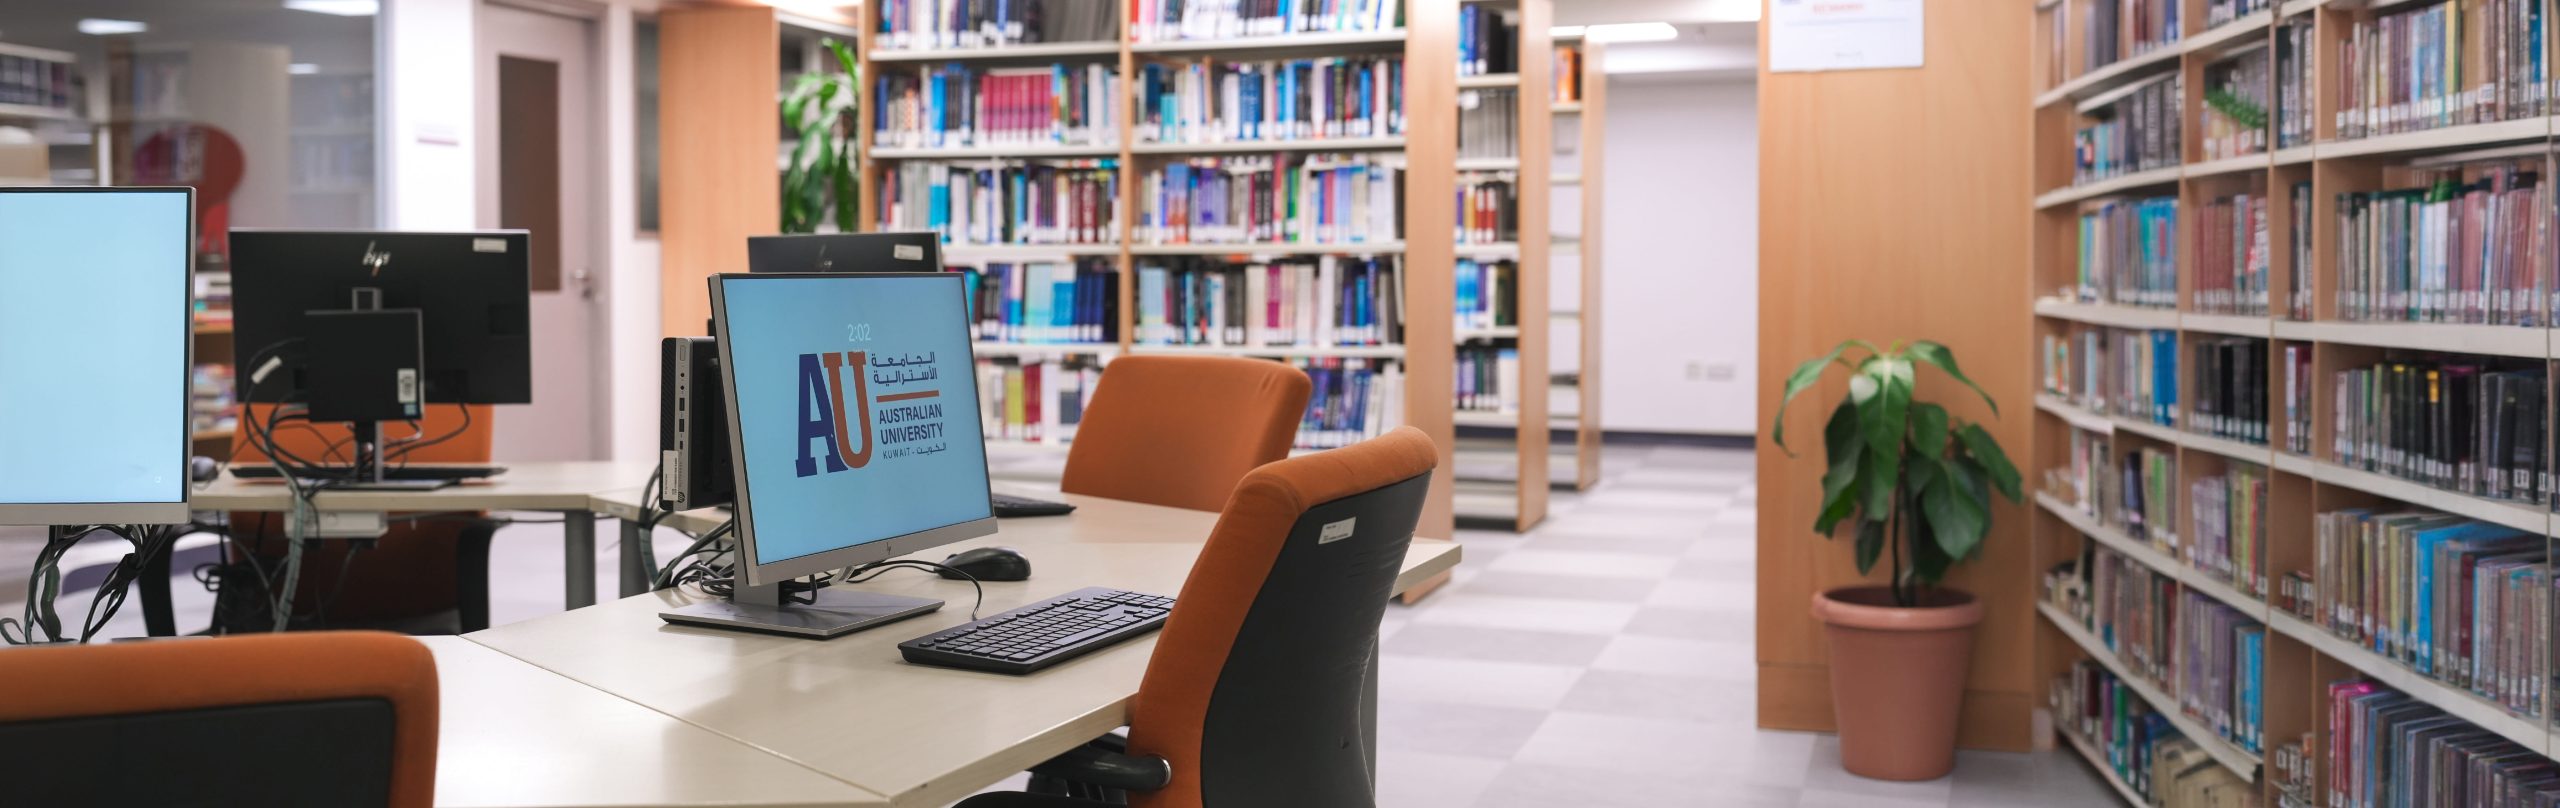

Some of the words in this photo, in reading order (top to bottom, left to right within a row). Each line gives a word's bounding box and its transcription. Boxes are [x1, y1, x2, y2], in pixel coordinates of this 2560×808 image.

[847, 323, 871, 342] 2:02
[871, 351, 936, 368] الجامعة
[873, 367, 938, 387] الأسترالية
[795, 351, 873, 478] AU
[879, 403, 943, 425] AUSTRALIAN
[880, 422, 944, 445] UNIVERSITY
[882, 447, 911, 460] KUWAIT
[916, 442, 947, 455] الكويت
